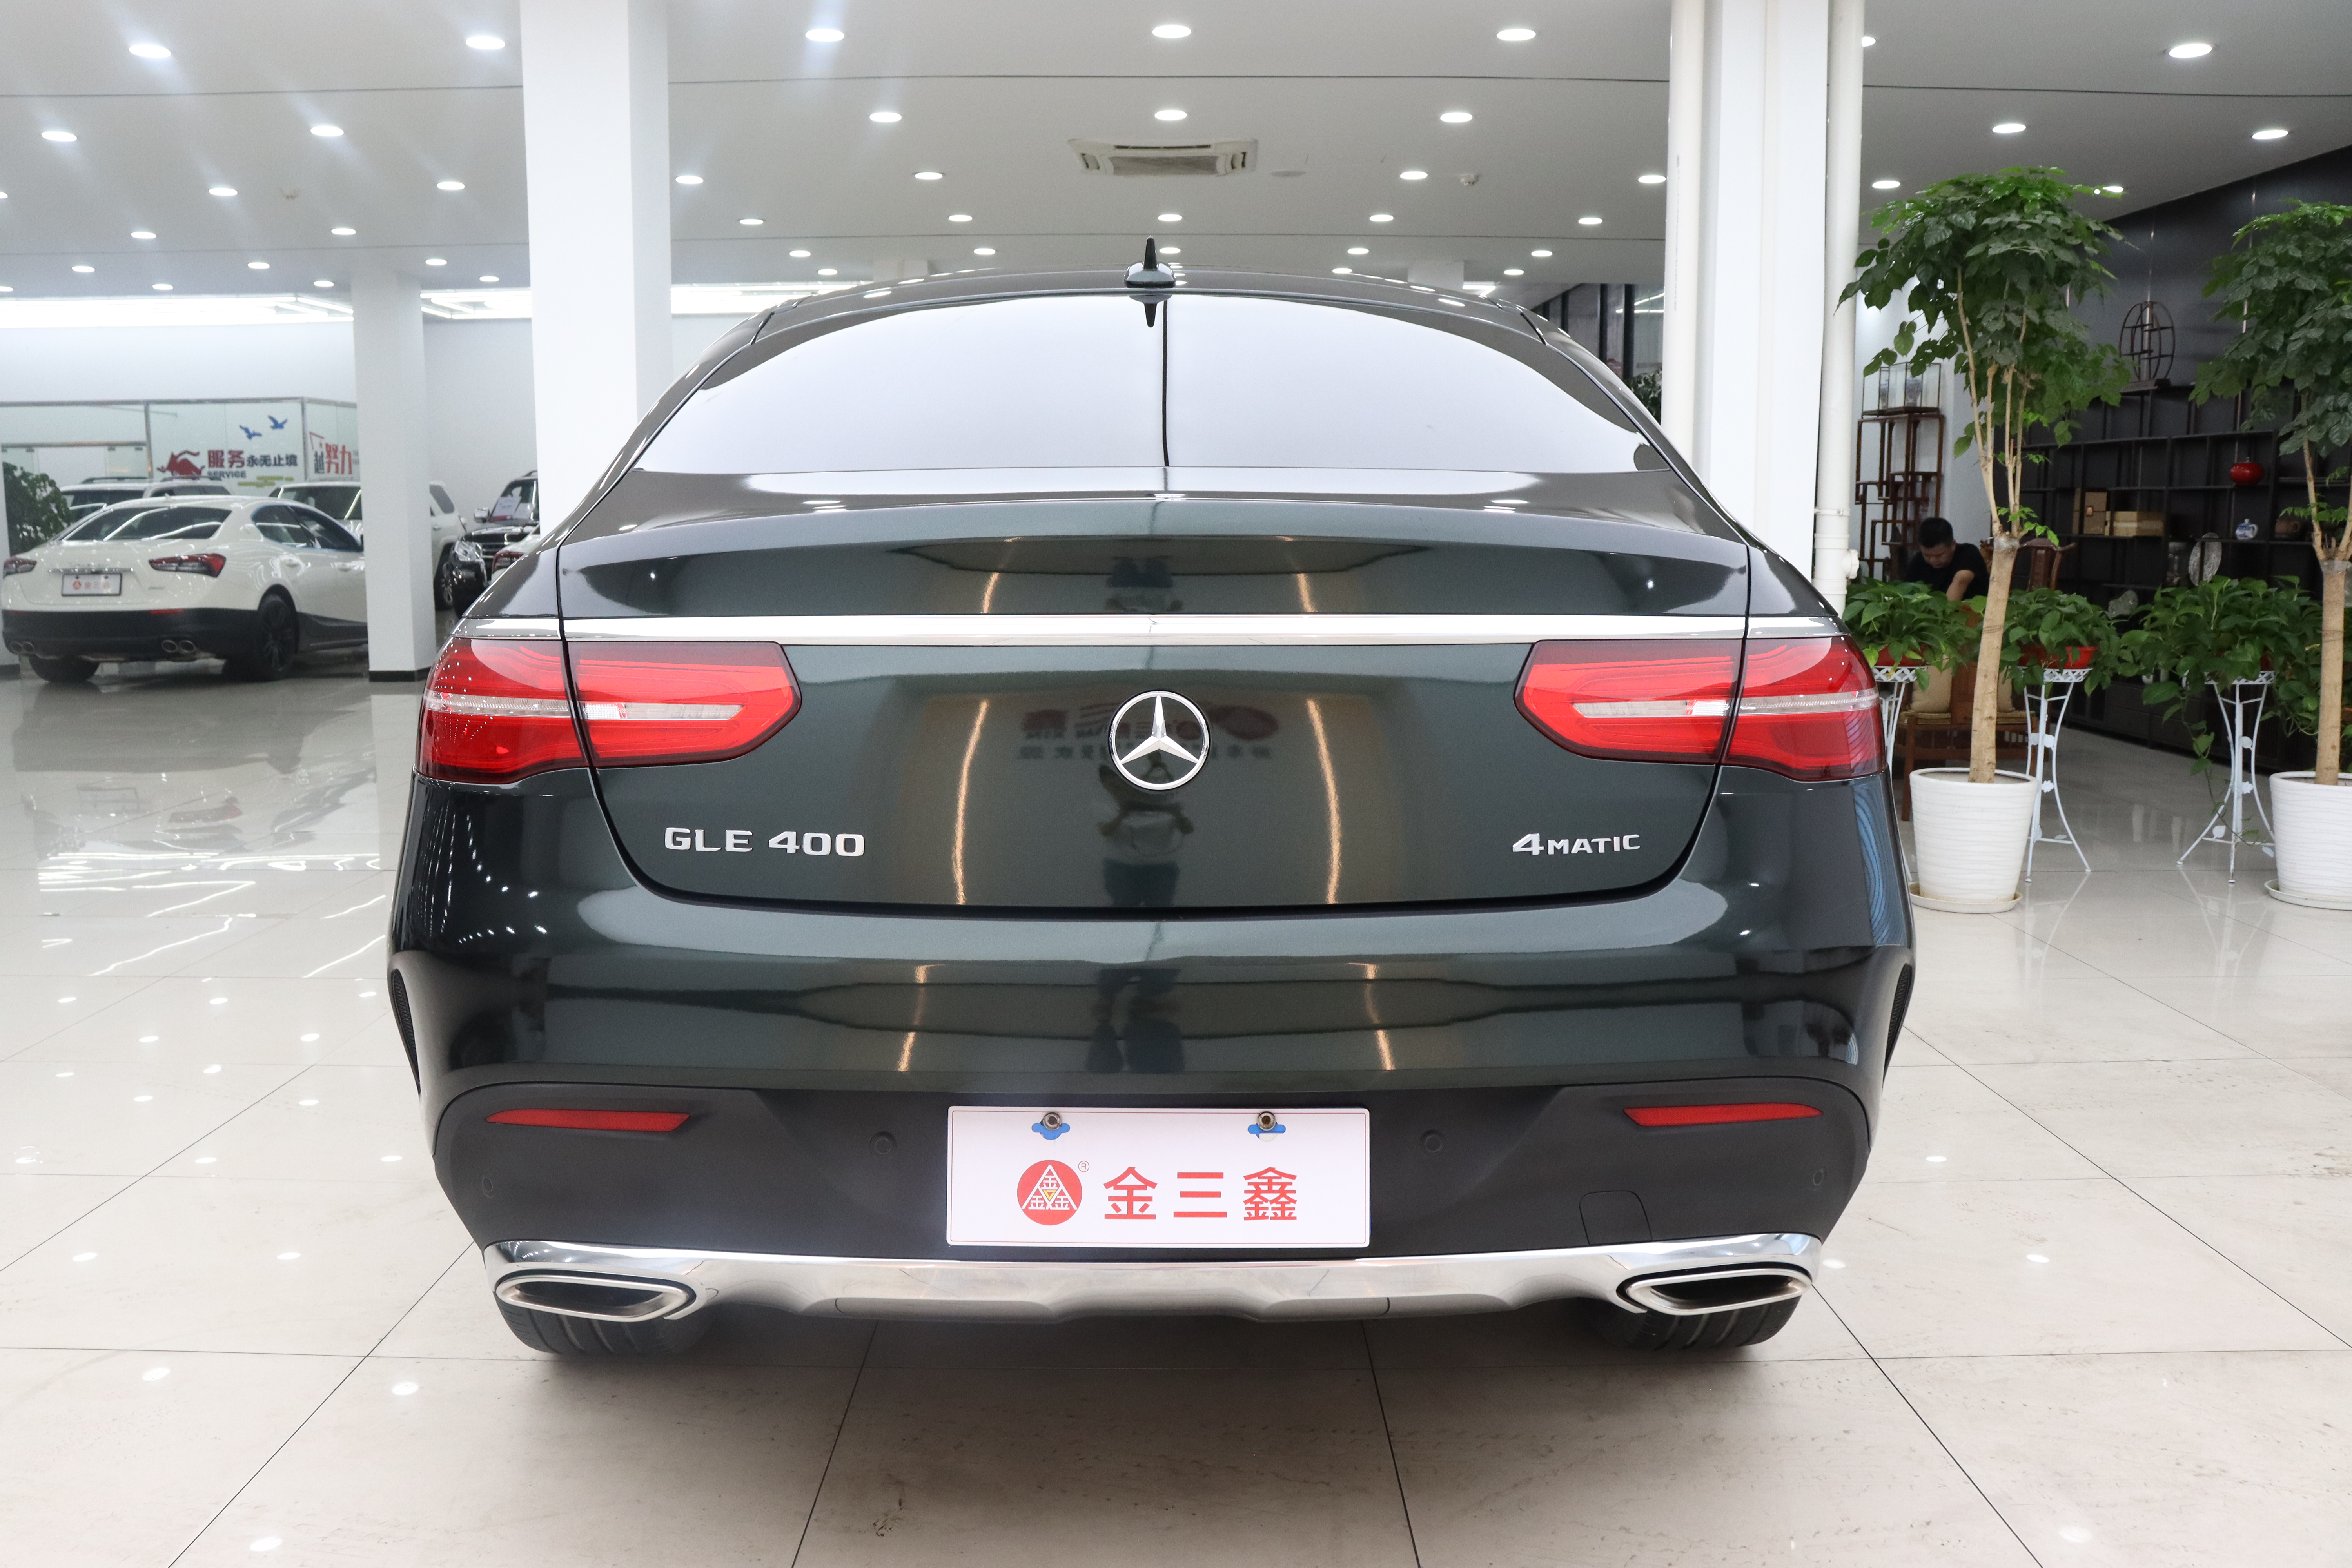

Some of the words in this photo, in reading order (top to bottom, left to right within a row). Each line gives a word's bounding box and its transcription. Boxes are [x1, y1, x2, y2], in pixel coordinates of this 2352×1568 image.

[665, 827, 753, 852] GLE
[768, 831, 865, 857] 400
[1512, 833, 1641, 855] 4MATIC
[1103, 1166, 1298, 1221] 金三鑫
